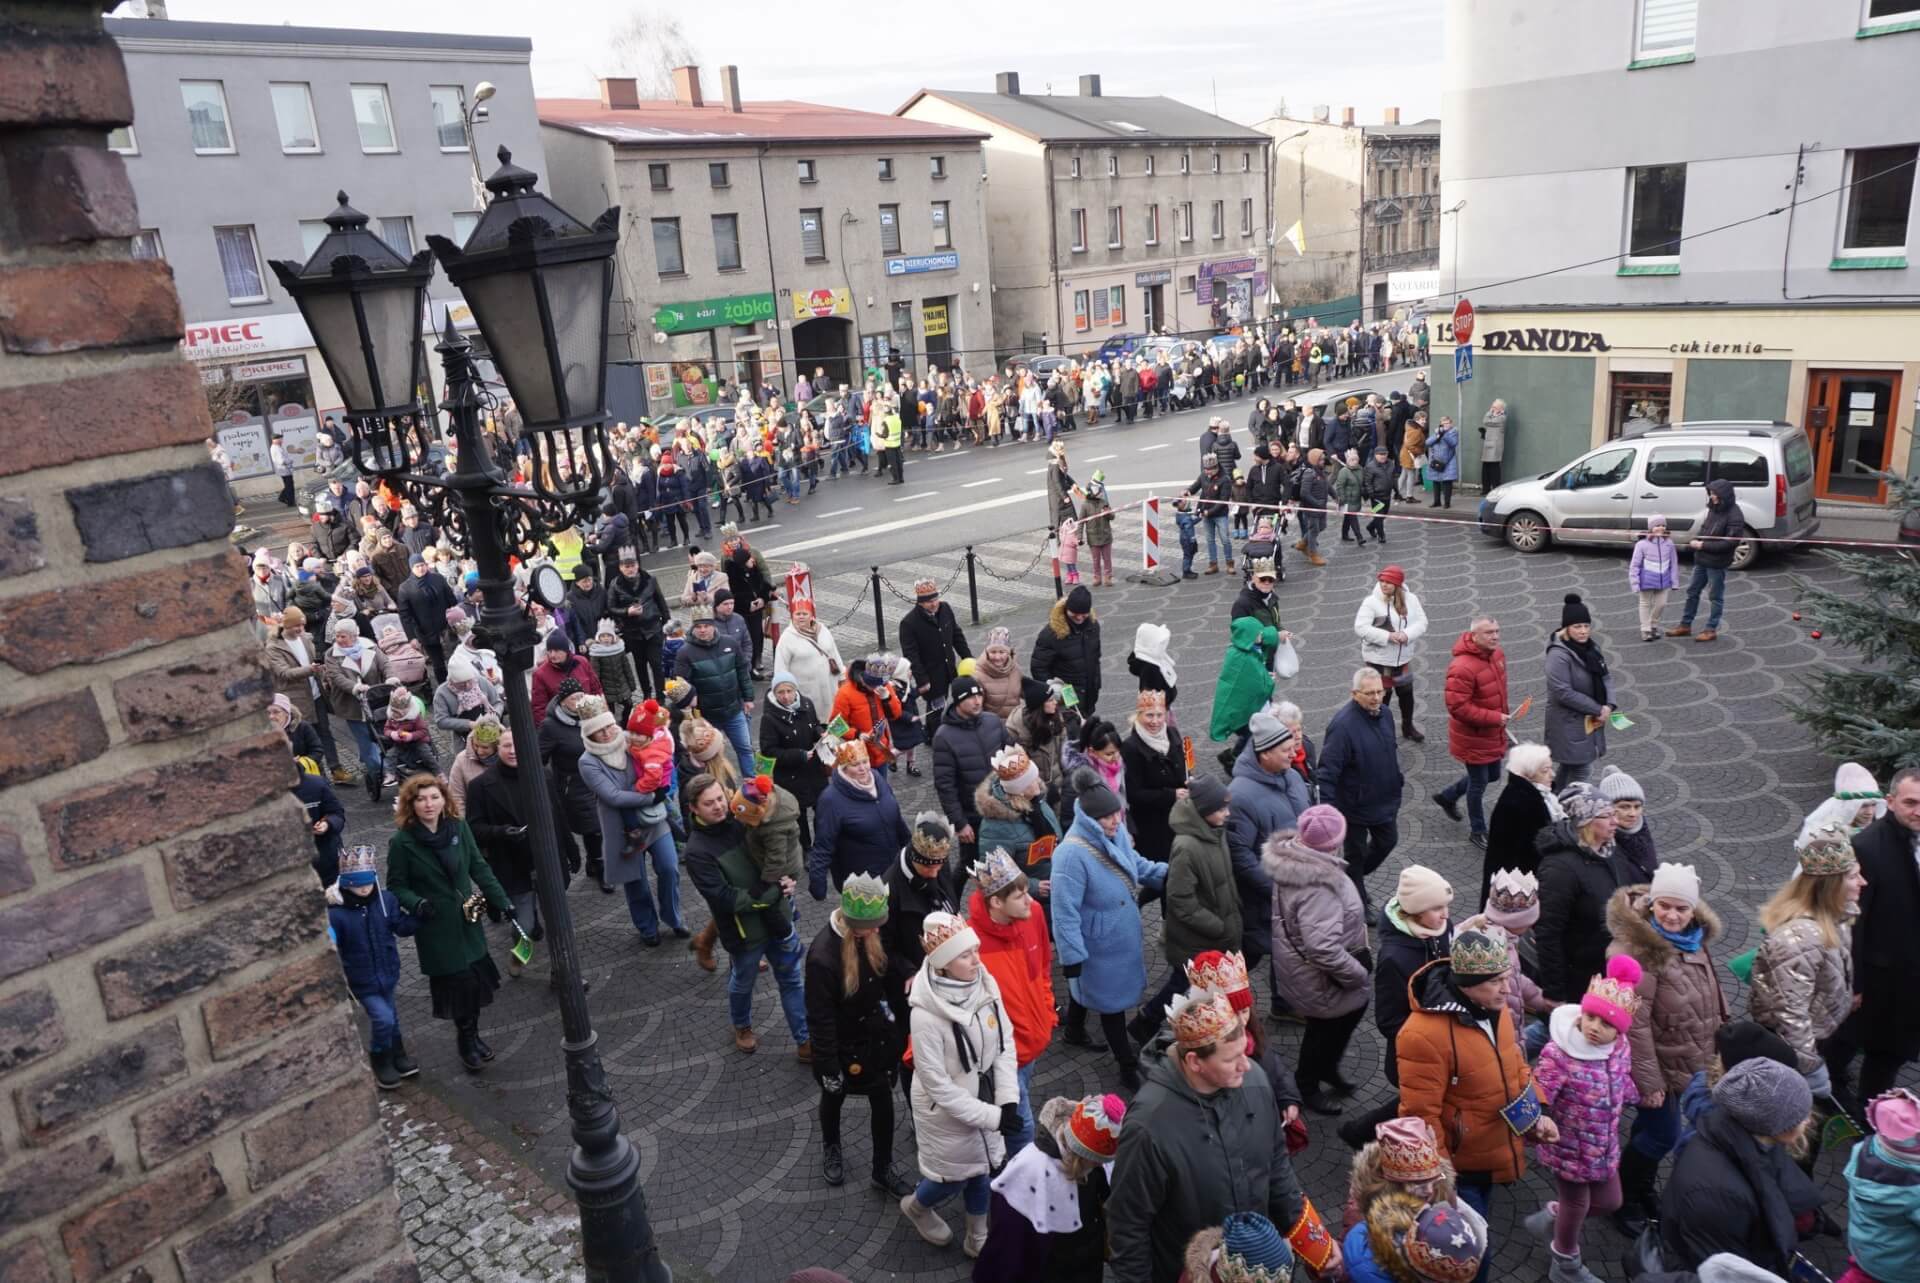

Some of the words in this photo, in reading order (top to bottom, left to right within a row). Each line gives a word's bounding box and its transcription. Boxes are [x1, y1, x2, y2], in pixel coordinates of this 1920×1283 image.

[779, 288, 791, 297] 171
[724, 298, 772, 319] żabka
[922, 309, 946, 322] YNAJMĘ
[1455, 313, 1472, 331] STOP
[184, 322, 263, 347] PIEC
[1482, 328, 1611, 352] DANUTA
[1670, 340, 1763, 353] cukiernia
[252, 362, 295, 373] KUPIEC
